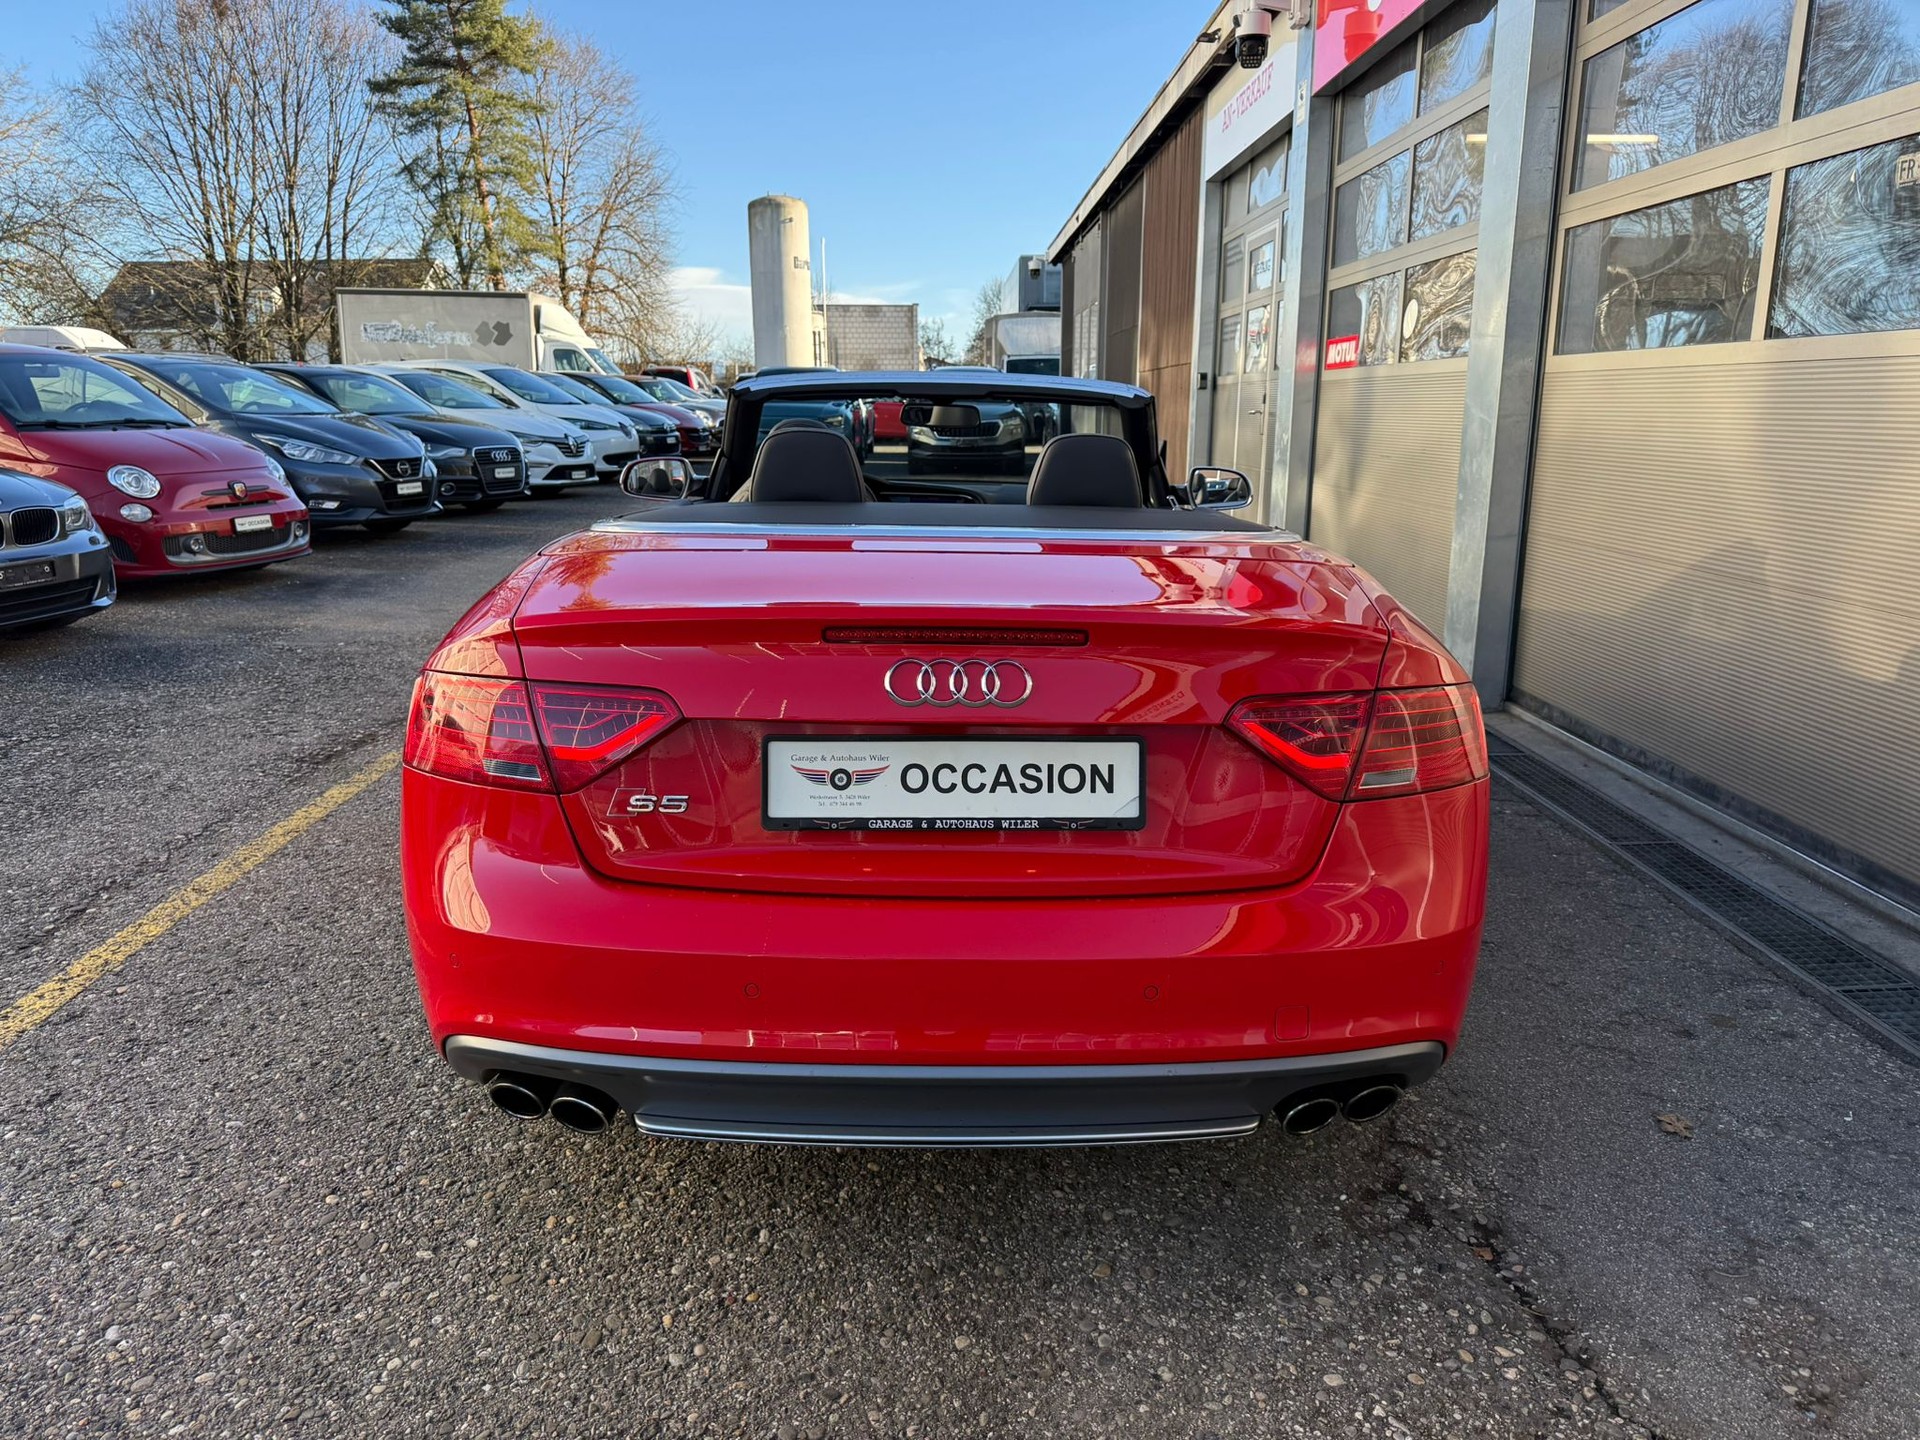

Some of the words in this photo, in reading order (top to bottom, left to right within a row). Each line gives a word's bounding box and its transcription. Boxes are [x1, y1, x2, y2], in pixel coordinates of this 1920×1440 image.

[1326, 340, 1356, 365] MOTUL
[790, 754, 819, 763] Garage
[900, 763, 1114, 794] OCCASION
[626, 794, 689, 813] S5
[868, 819, 913, 829] GARAGE
[921, 819, 928, 829] &
[935, 819, 994, 829] AUTOHAUS
[1001, 819, 1039, 829] WILER
